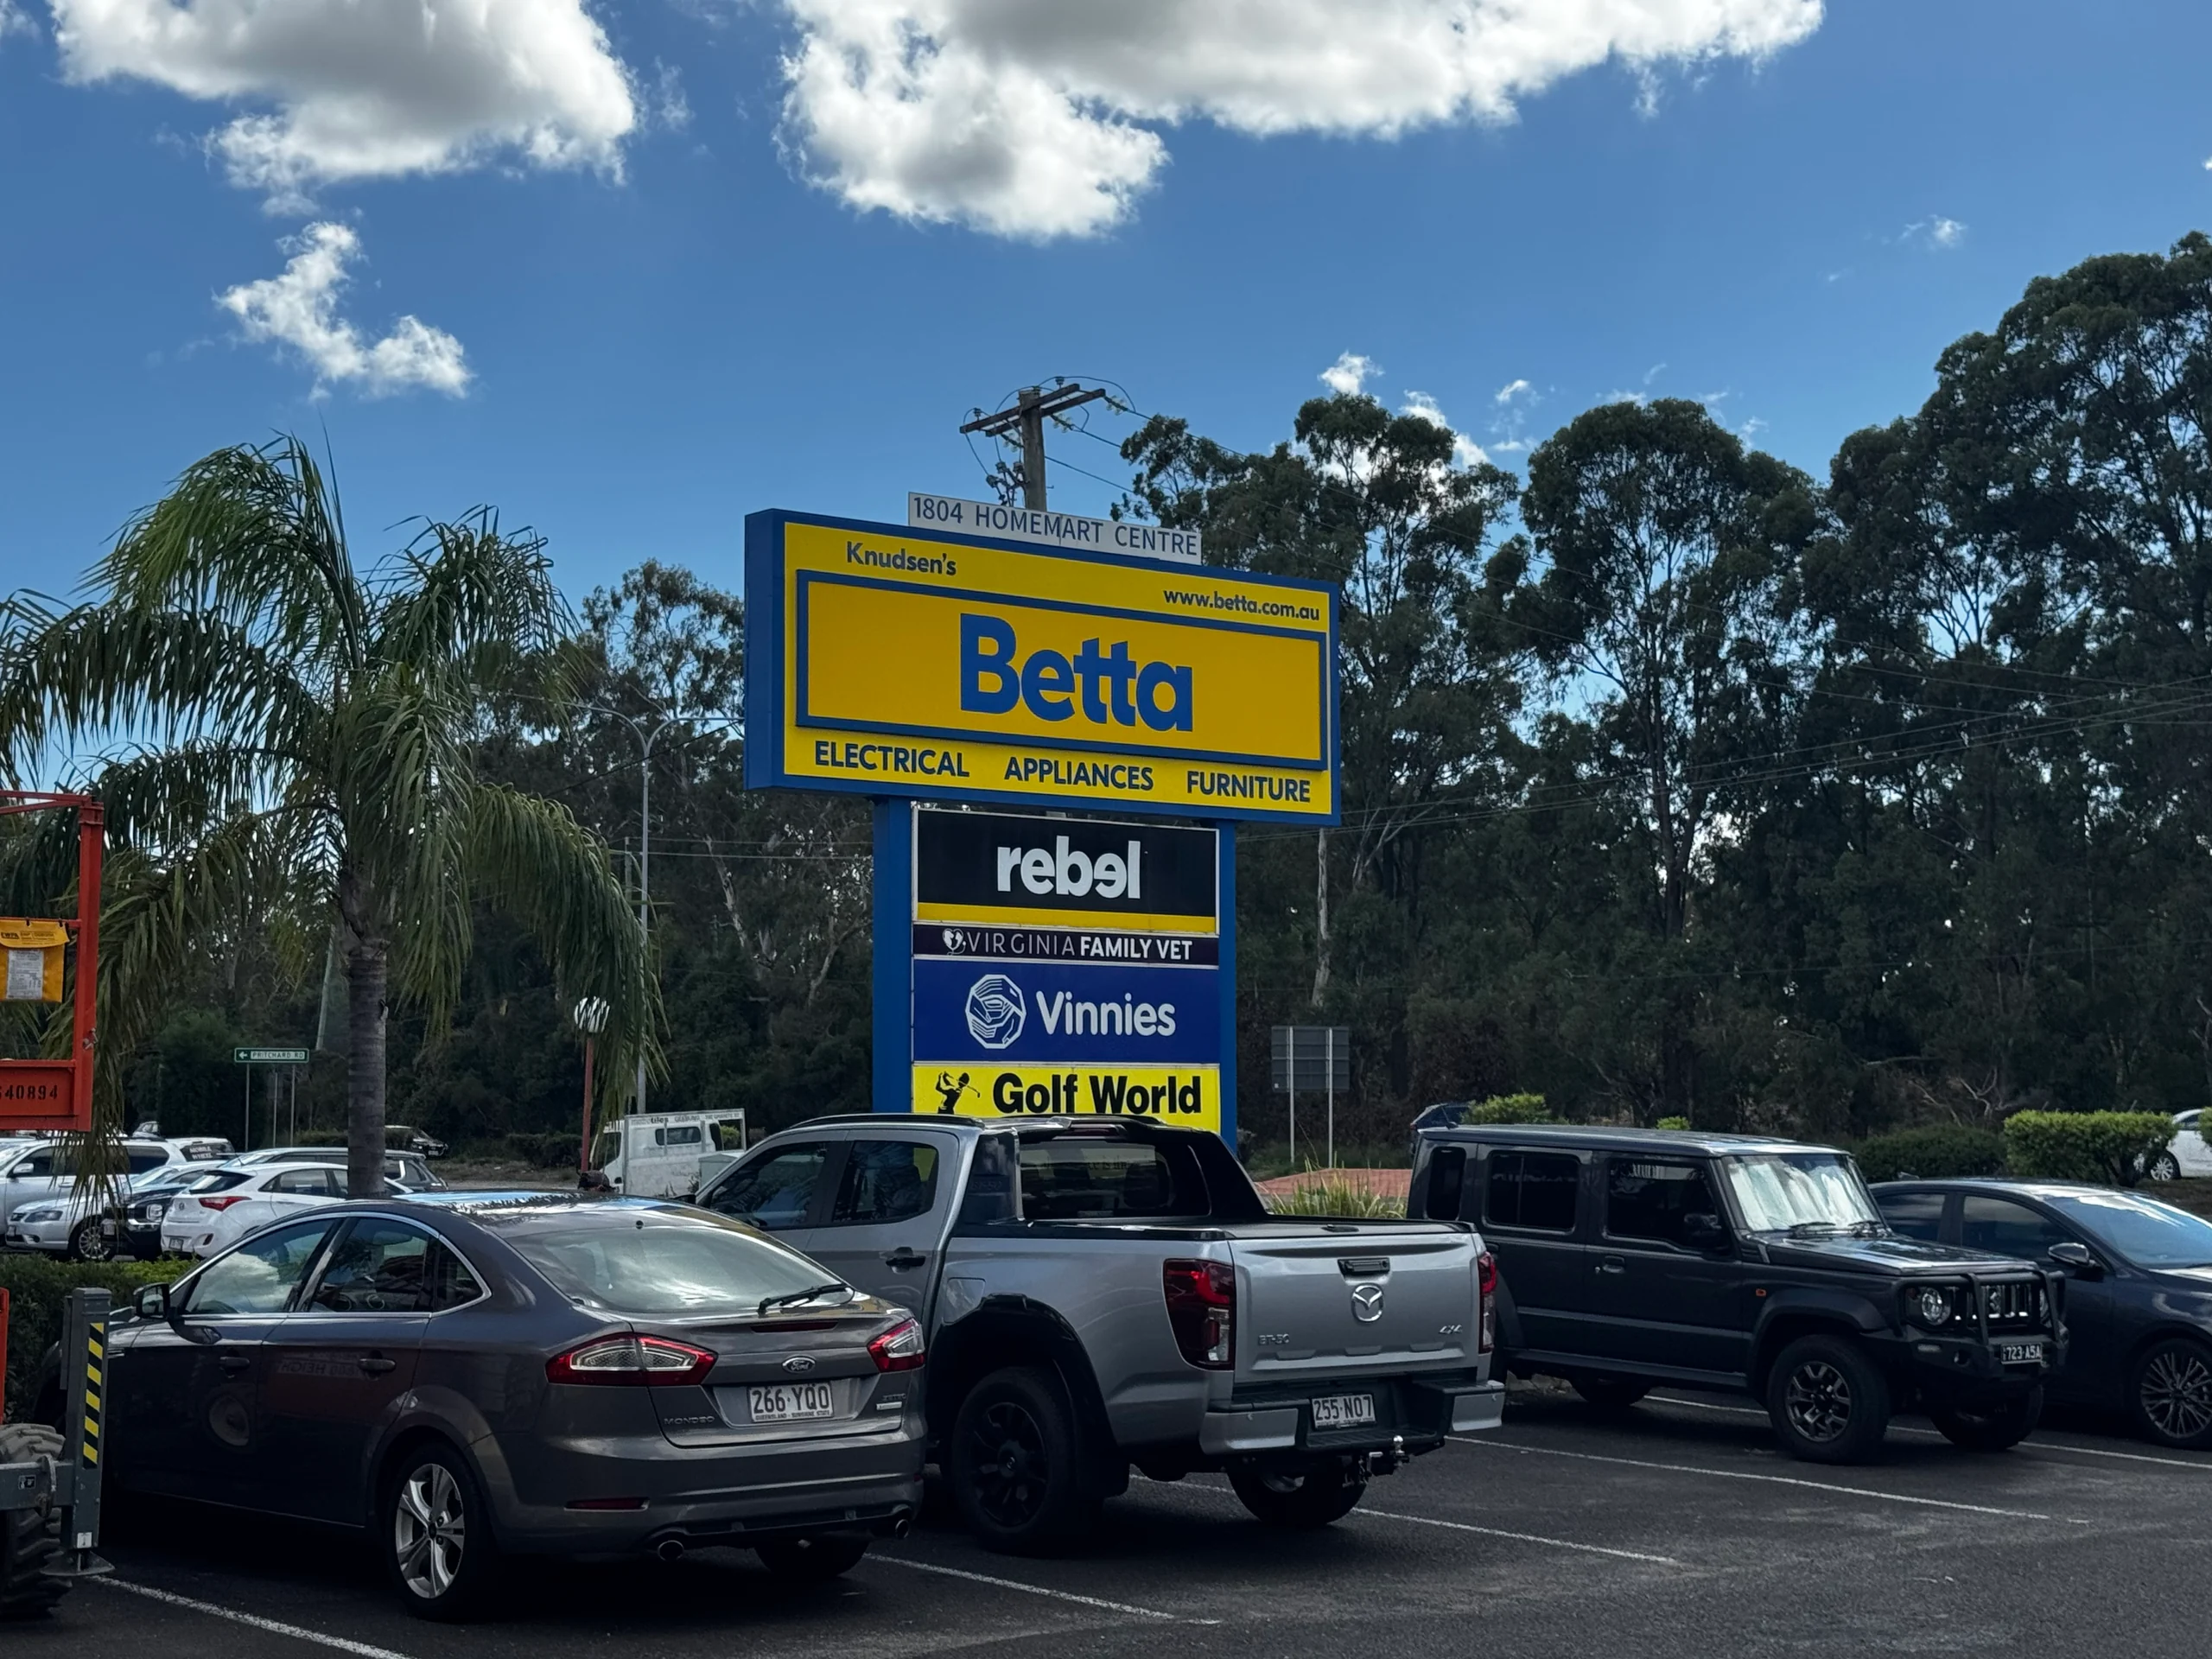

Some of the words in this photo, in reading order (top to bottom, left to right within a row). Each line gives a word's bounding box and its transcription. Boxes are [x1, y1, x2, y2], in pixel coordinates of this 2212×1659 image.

[913, 496, 963, 524] 1804
[975, 504, 1103, 543] HOMEMART
[1114, 525, 1198, 556] CENTRE
[846, 541, 957, 576] Knudsen's
[1163, 589, 1321, 622] www.betta.com.au
[959, 613, 1193, 733] Betta
[815, 741, 969, 779] ELECTRICAL
[1004, 756, 1154, 791] APPLIANCES
[1186, 771, 1311, 804] FURNITURE
[996, 836, 1141, 899] rebel
[965, 931, 1076, 957] VIRGINIA
[1079, 935, 1153, 960] FAMILY
[1155, 938, 1193, 962] VET
[1035, 990, 1177, 1037] Vinnies
[992, 1072, 1078, 1114] Golf
[1088, 1075, 1202, 1115] World
[664, 1415, 715, 1426] MONDEO
